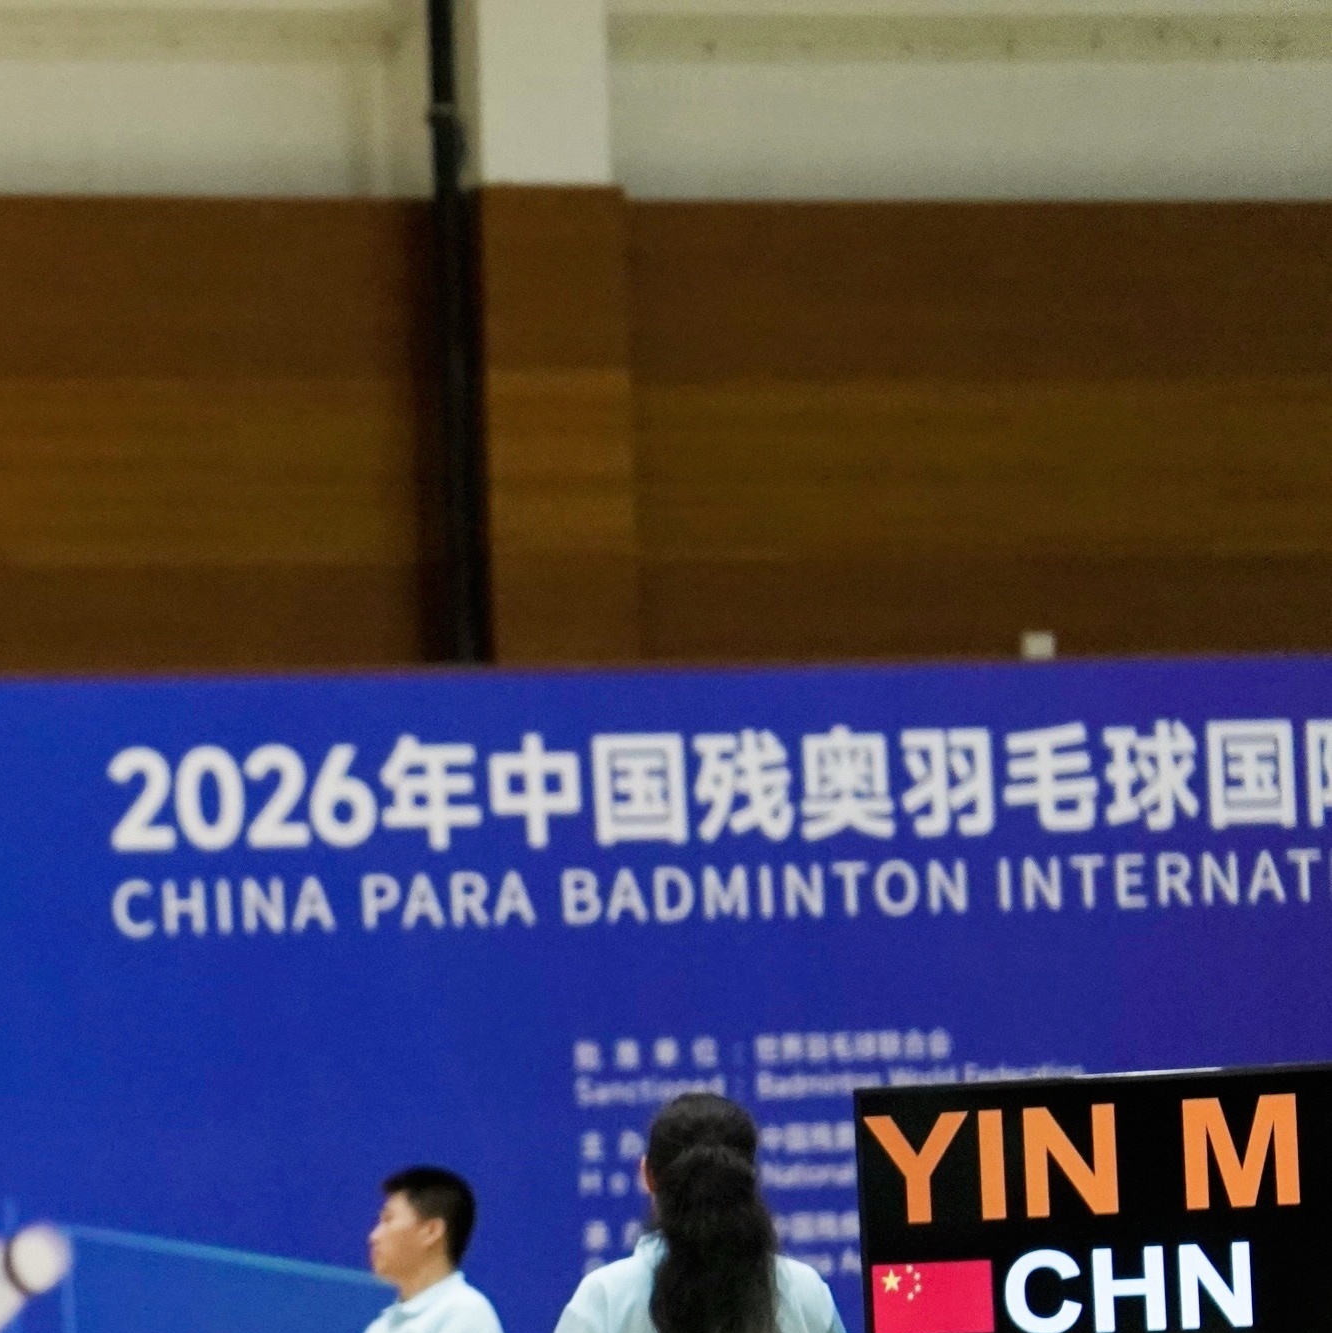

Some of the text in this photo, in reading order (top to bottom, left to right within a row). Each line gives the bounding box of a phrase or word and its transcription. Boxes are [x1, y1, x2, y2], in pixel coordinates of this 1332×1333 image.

[106, 716, 1332, 852] 2026年中国残奥羽毛球国
[110, 846, 1332, 940] CHINA PARA BADMINTON INTERNAT
[863, 1092, 1301, 1224] YIN M
